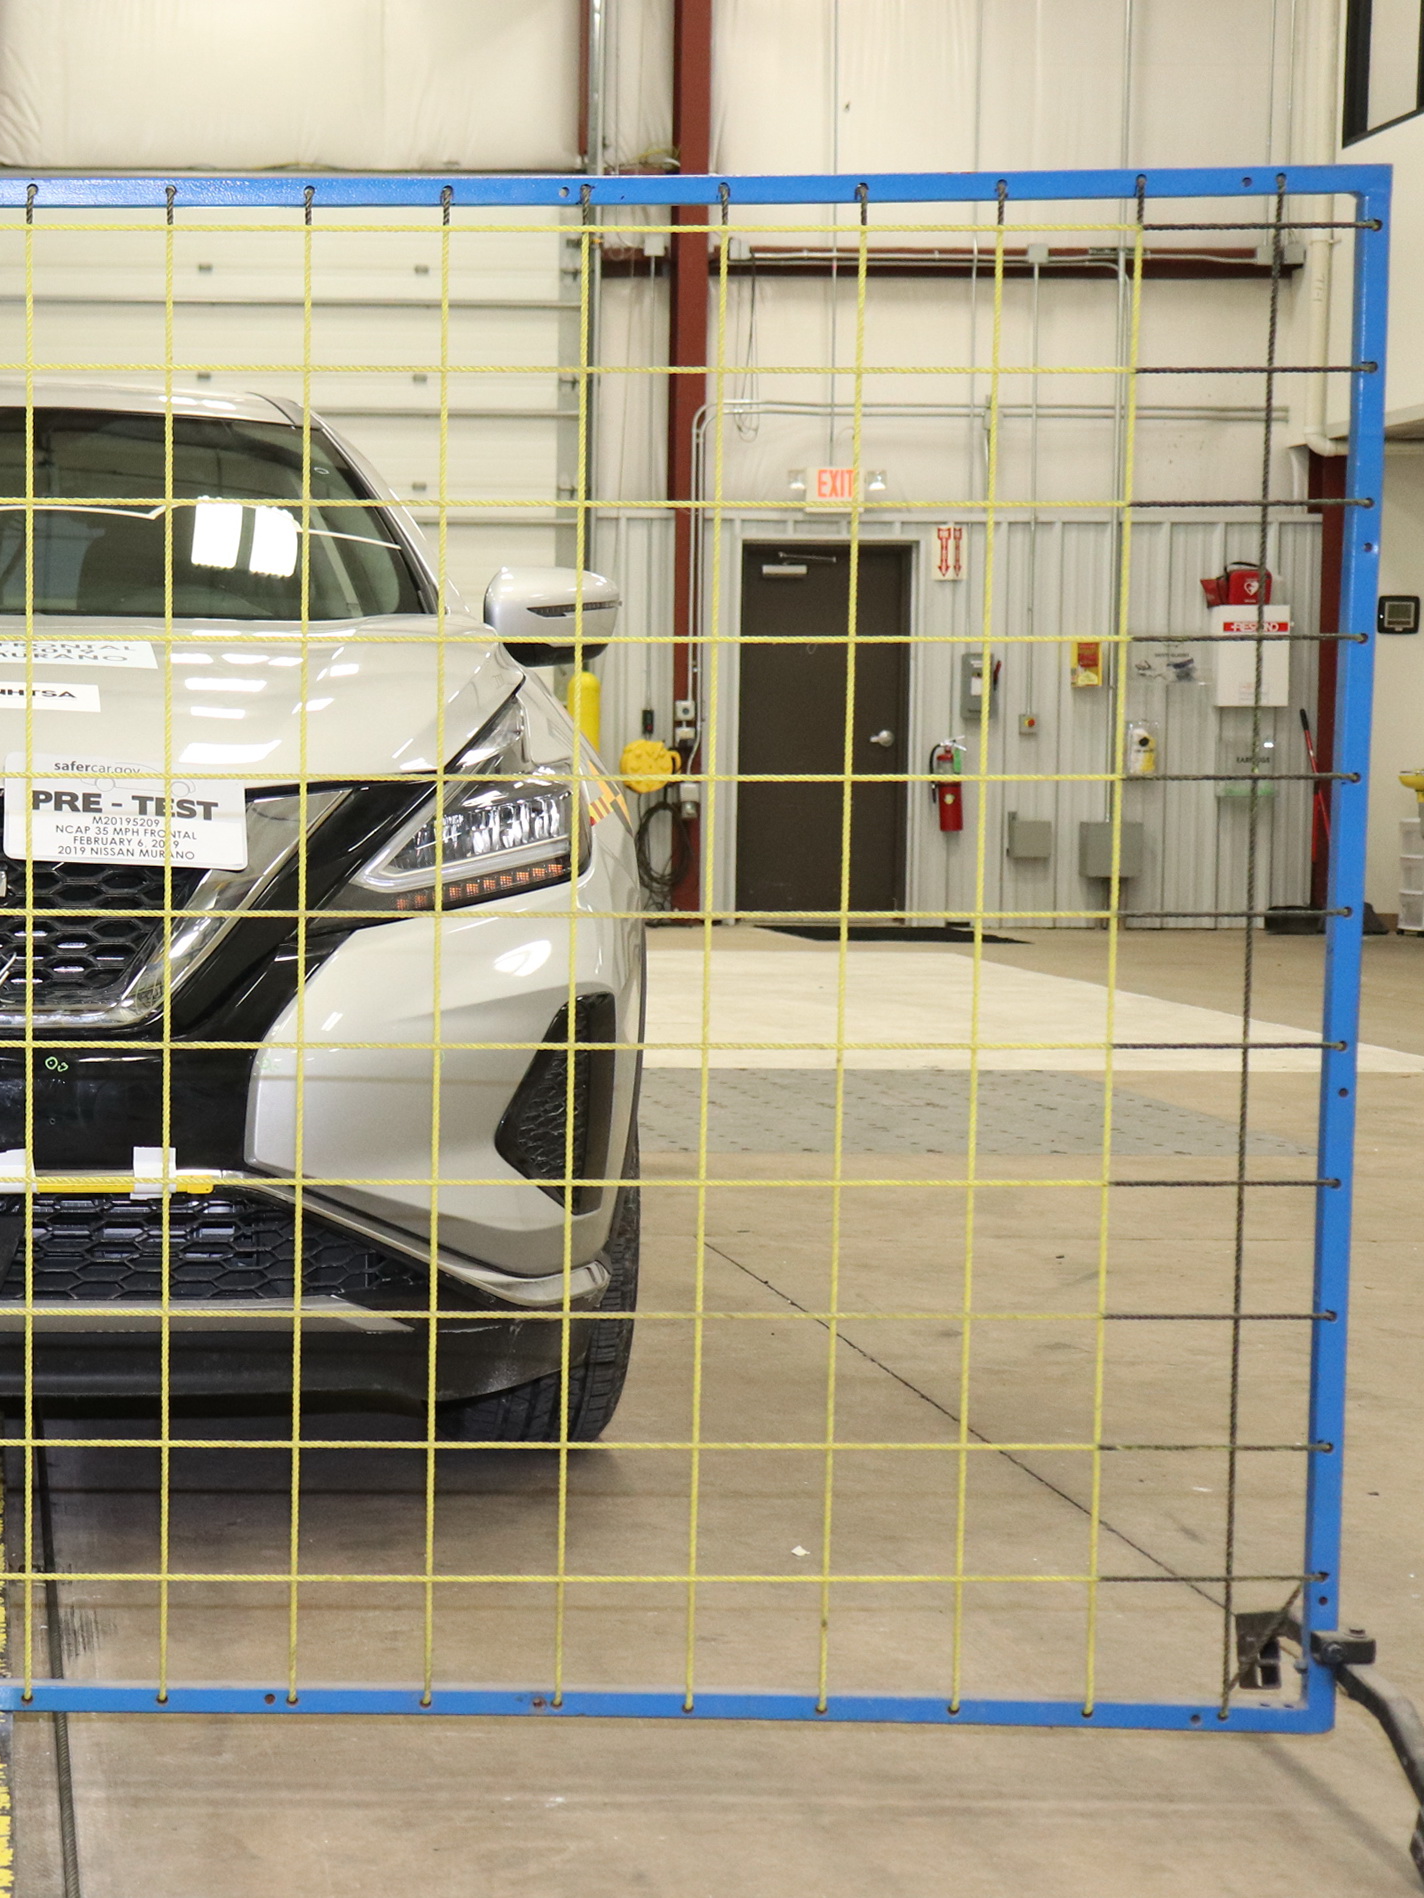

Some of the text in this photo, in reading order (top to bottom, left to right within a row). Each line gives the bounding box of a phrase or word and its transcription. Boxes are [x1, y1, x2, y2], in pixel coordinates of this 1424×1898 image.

[817, 469, 856, 498] EXIT
[1232, 621, 1279, 632] RESPND
[53, 760, 142, 776] safercar.gov
[31, 789, 103, 813] PRE
[131, 794, 219, 821] TEST
[91, 816, 161, 827] M20195209
[55, 824, 198, 840] NCAP 35 MPH FRONTAL
[73, 835, 133, 847] FEBRUARY
[151, 839, 180, 849] 209
[57, 845, 87, 855] 2019
[90, 847, 135, 857] NISSAN
